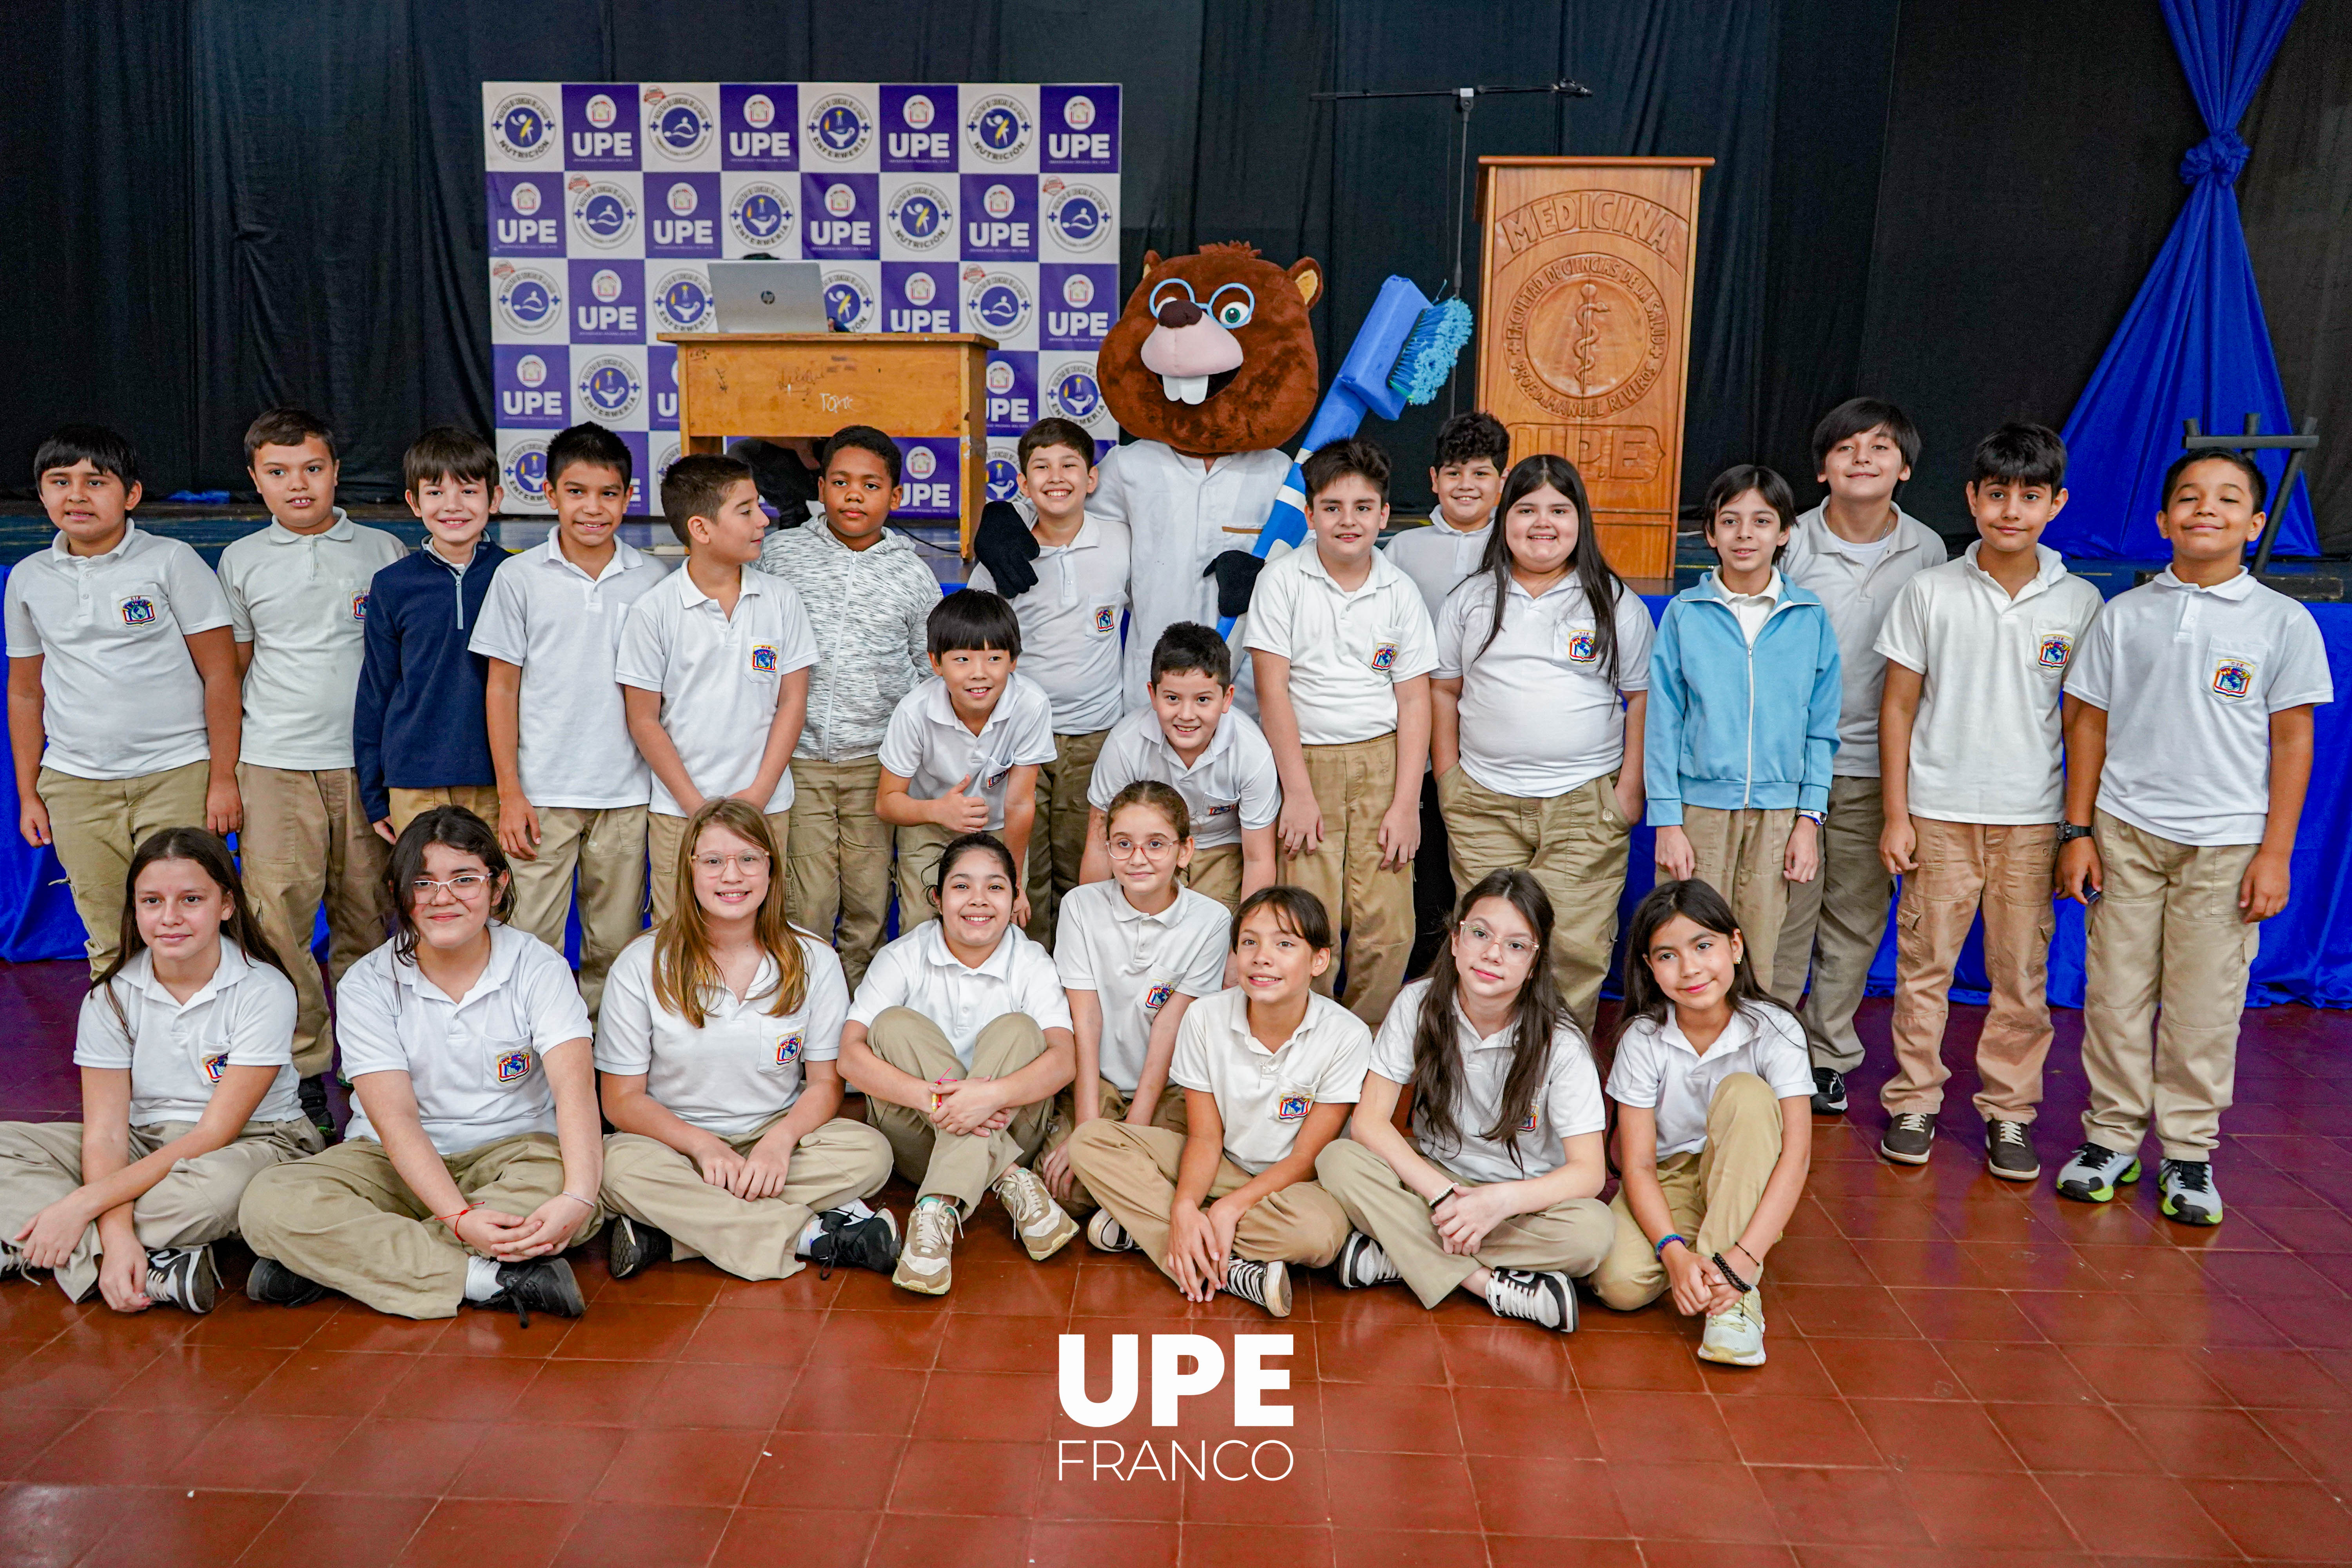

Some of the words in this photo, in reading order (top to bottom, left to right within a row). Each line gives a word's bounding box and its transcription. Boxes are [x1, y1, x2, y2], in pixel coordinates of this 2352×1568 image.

[573, 132, 632, 156] UPE
[730, 132, 790, 156] UPE
[889, 133, 950, 158] UPE
[1049, 134, 1110, 158] UPE
[497, 219, 557, 243] UPE
[653, 220, 713, 244] UPE
[810, 221, 871, 245] UPE
[969, 222, 1029, 247] UPE
[1501, 193, 1677, 254] MEDICINA
[578, 306, 637, 330] UPE
[890, 309, 951, 333] UPE
[1048, 311, 1109, 336] UPE
[1506, 279, 1544, 339] FACULTAD
[1644, 300, 1666, 345] SALUD
[503, 391, 563, 416] UPE
[986, 398, 1029, 423] PE
